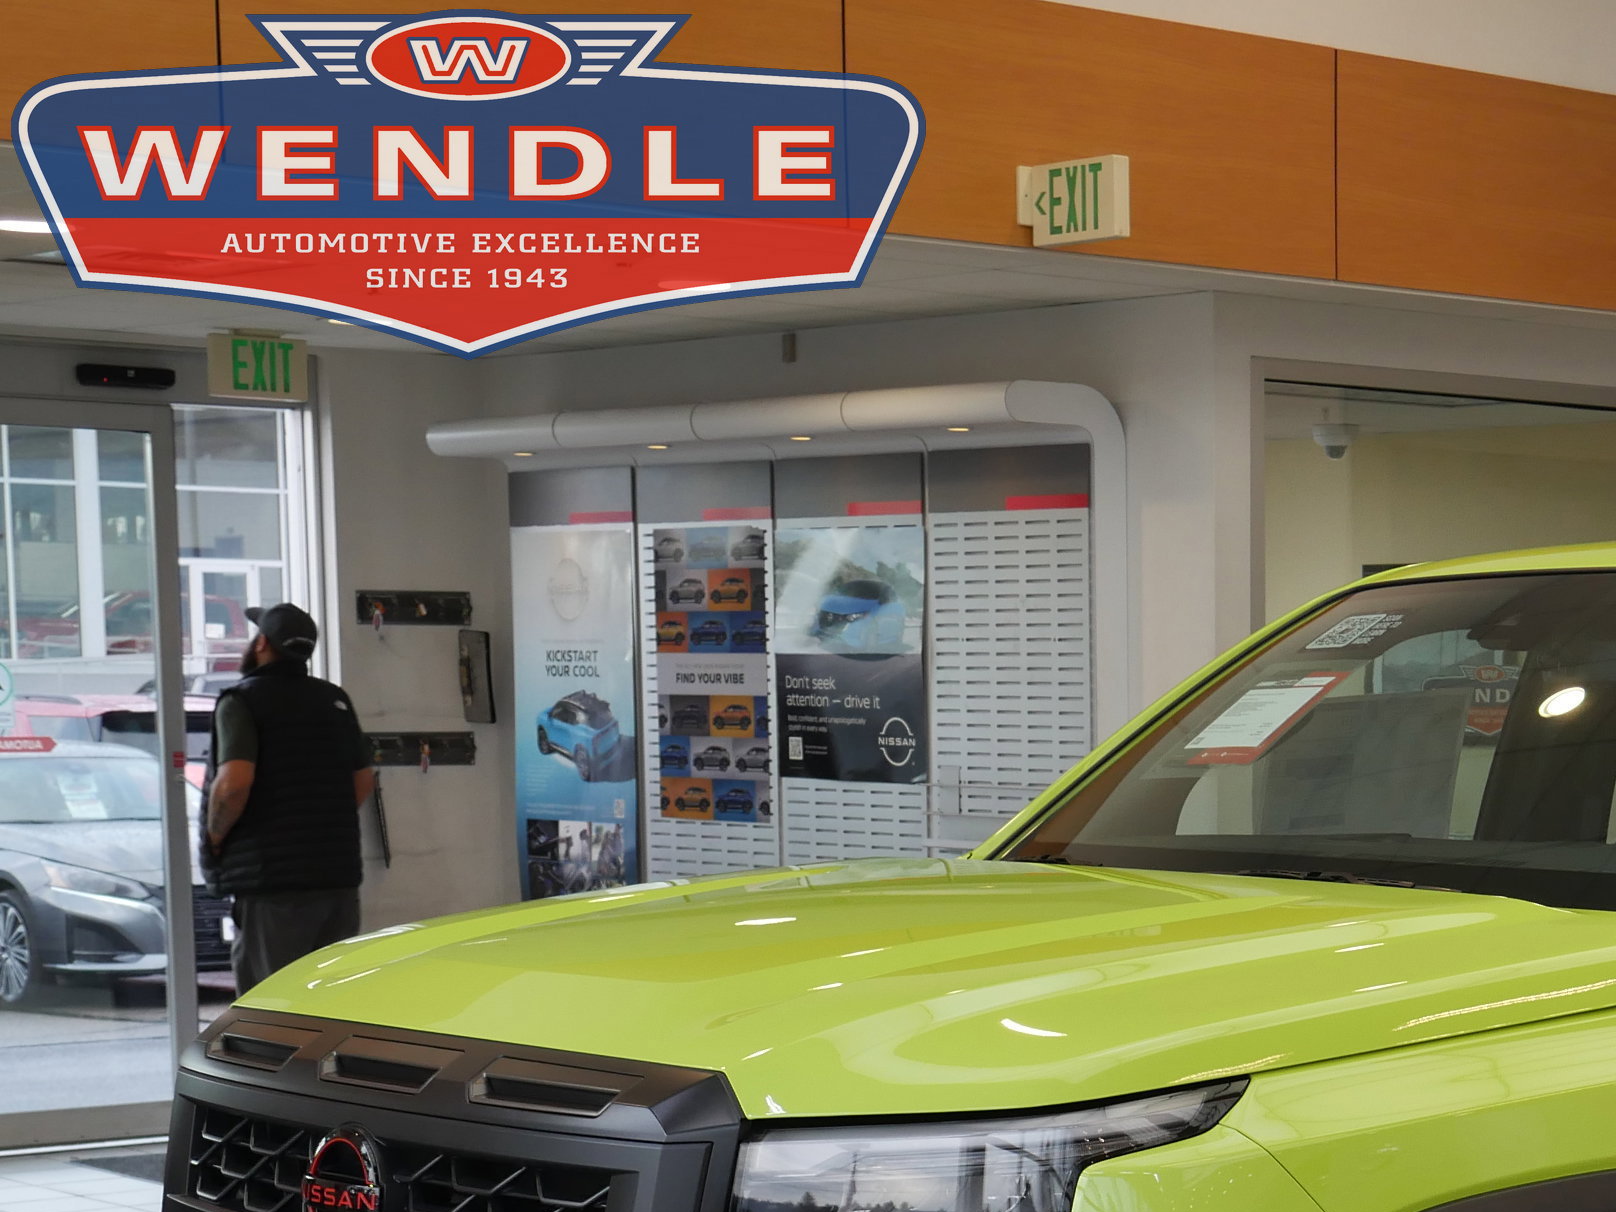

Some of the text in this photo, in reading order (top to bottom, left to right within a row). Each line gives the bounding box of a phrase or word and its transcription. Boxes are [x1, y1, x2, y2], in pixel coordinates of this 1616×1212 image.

[1048, 162, 1102, 235] EXIT
[231, 339, 294, 393] EXIT
[546, 650, 598, 662] KICKSTART
[545, 665, 600, 677] YOUR COOL
[675, 673, 744, 684] FIND YOUR VIBE
[785, 675, 836, 690] Don't seek
[786, 693, 829, 707] attention
[844, 695, 871, 709] drive
[873, 696, 881, 709] it
[878, 737, 916, 746] NISSAN
[305, 1180, 375, 1211] ISSAN
